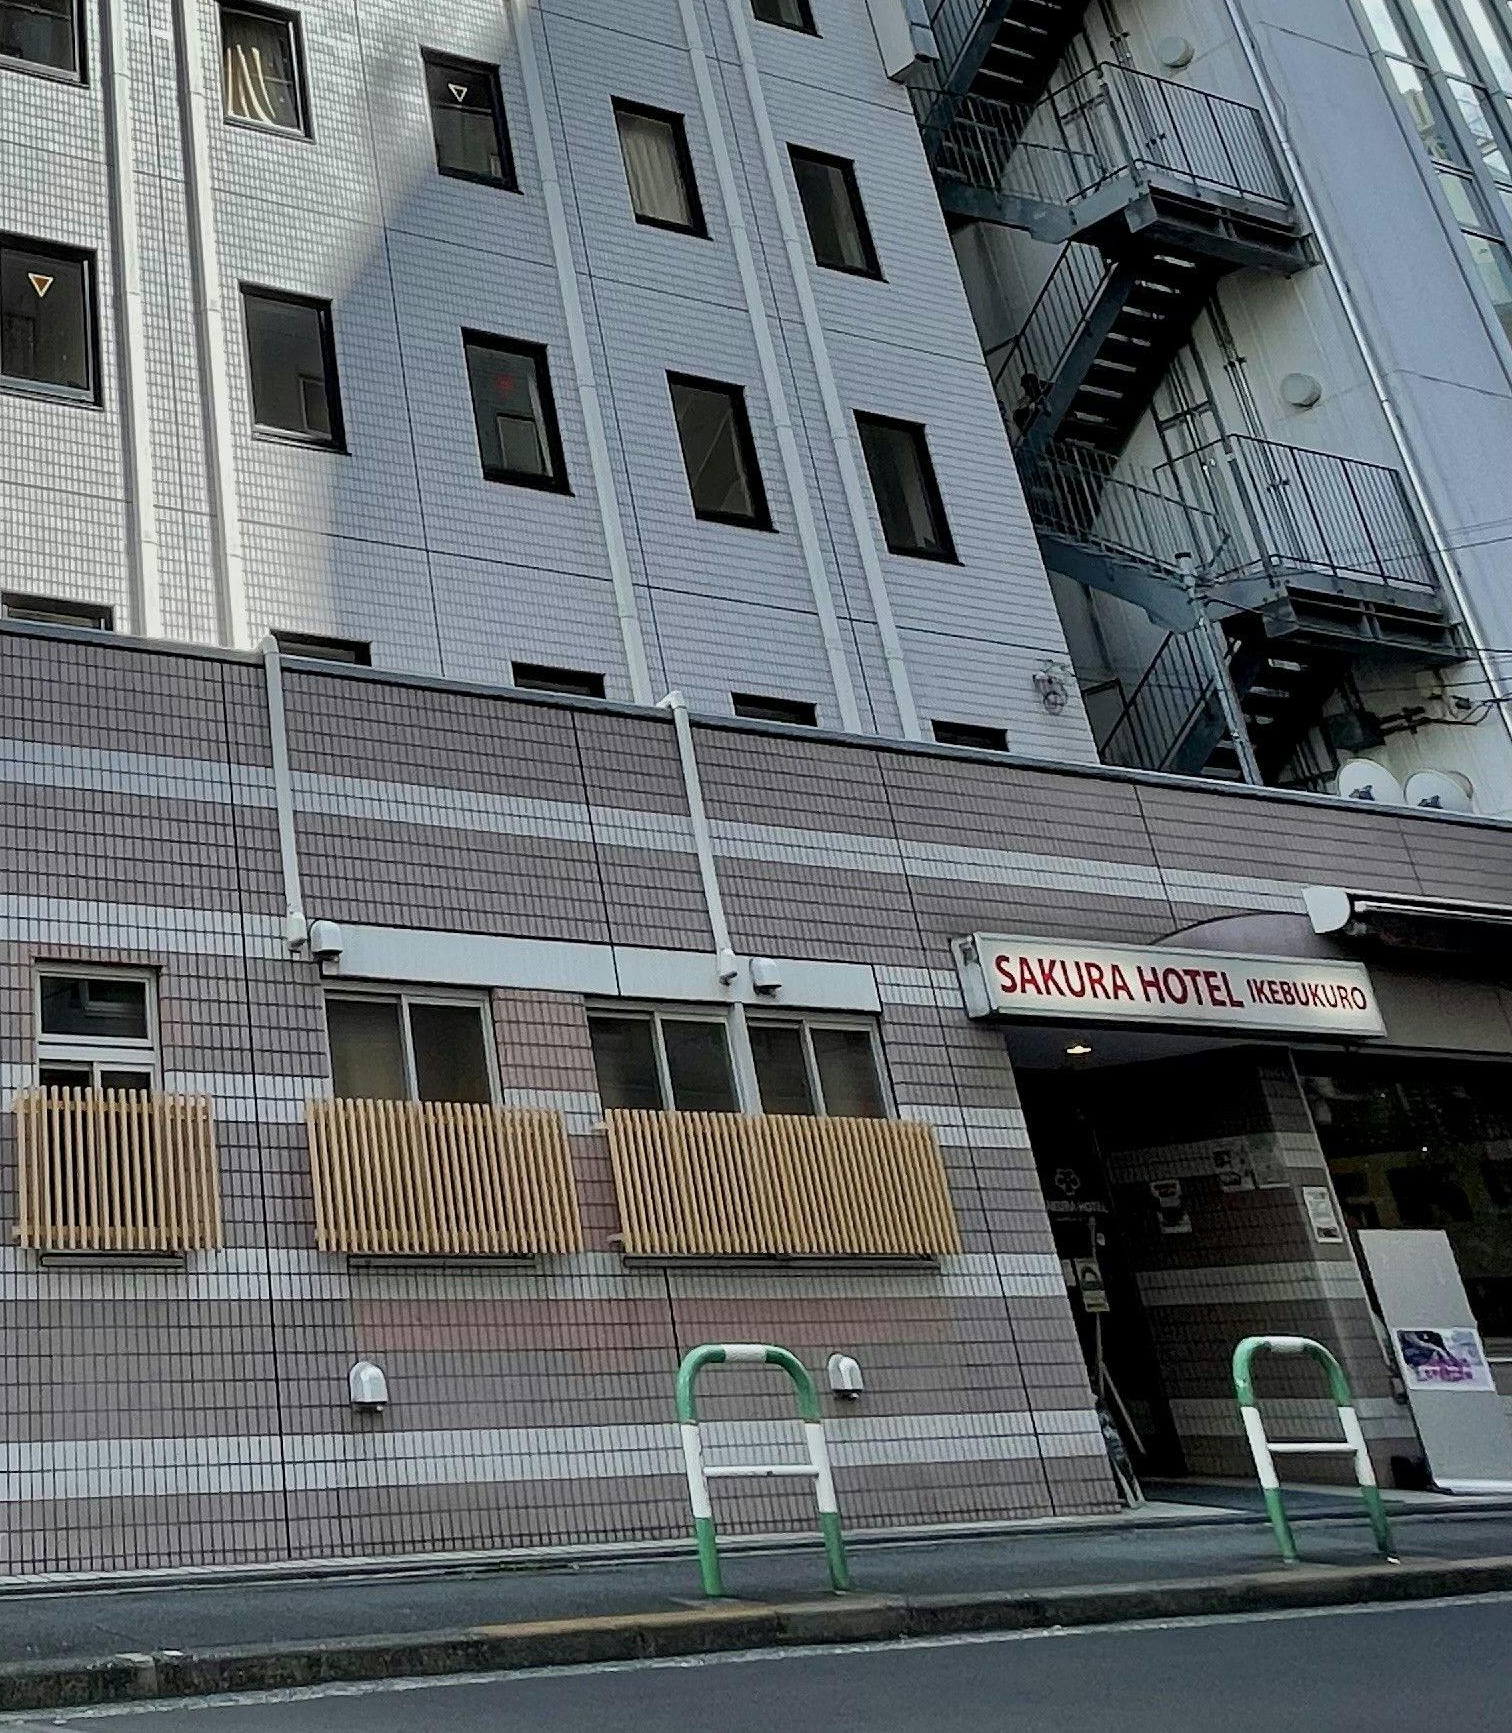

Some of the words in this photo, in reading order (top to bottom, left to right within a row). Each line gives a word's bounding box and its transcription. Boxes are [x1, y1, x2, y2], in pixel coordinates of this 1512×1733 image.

[994, 954, 1135, 1002] SAKURA
[1136, 965, 1245, 1009] HOTEL
[1246, 977, 1368, 1011] IKEBUKURO
